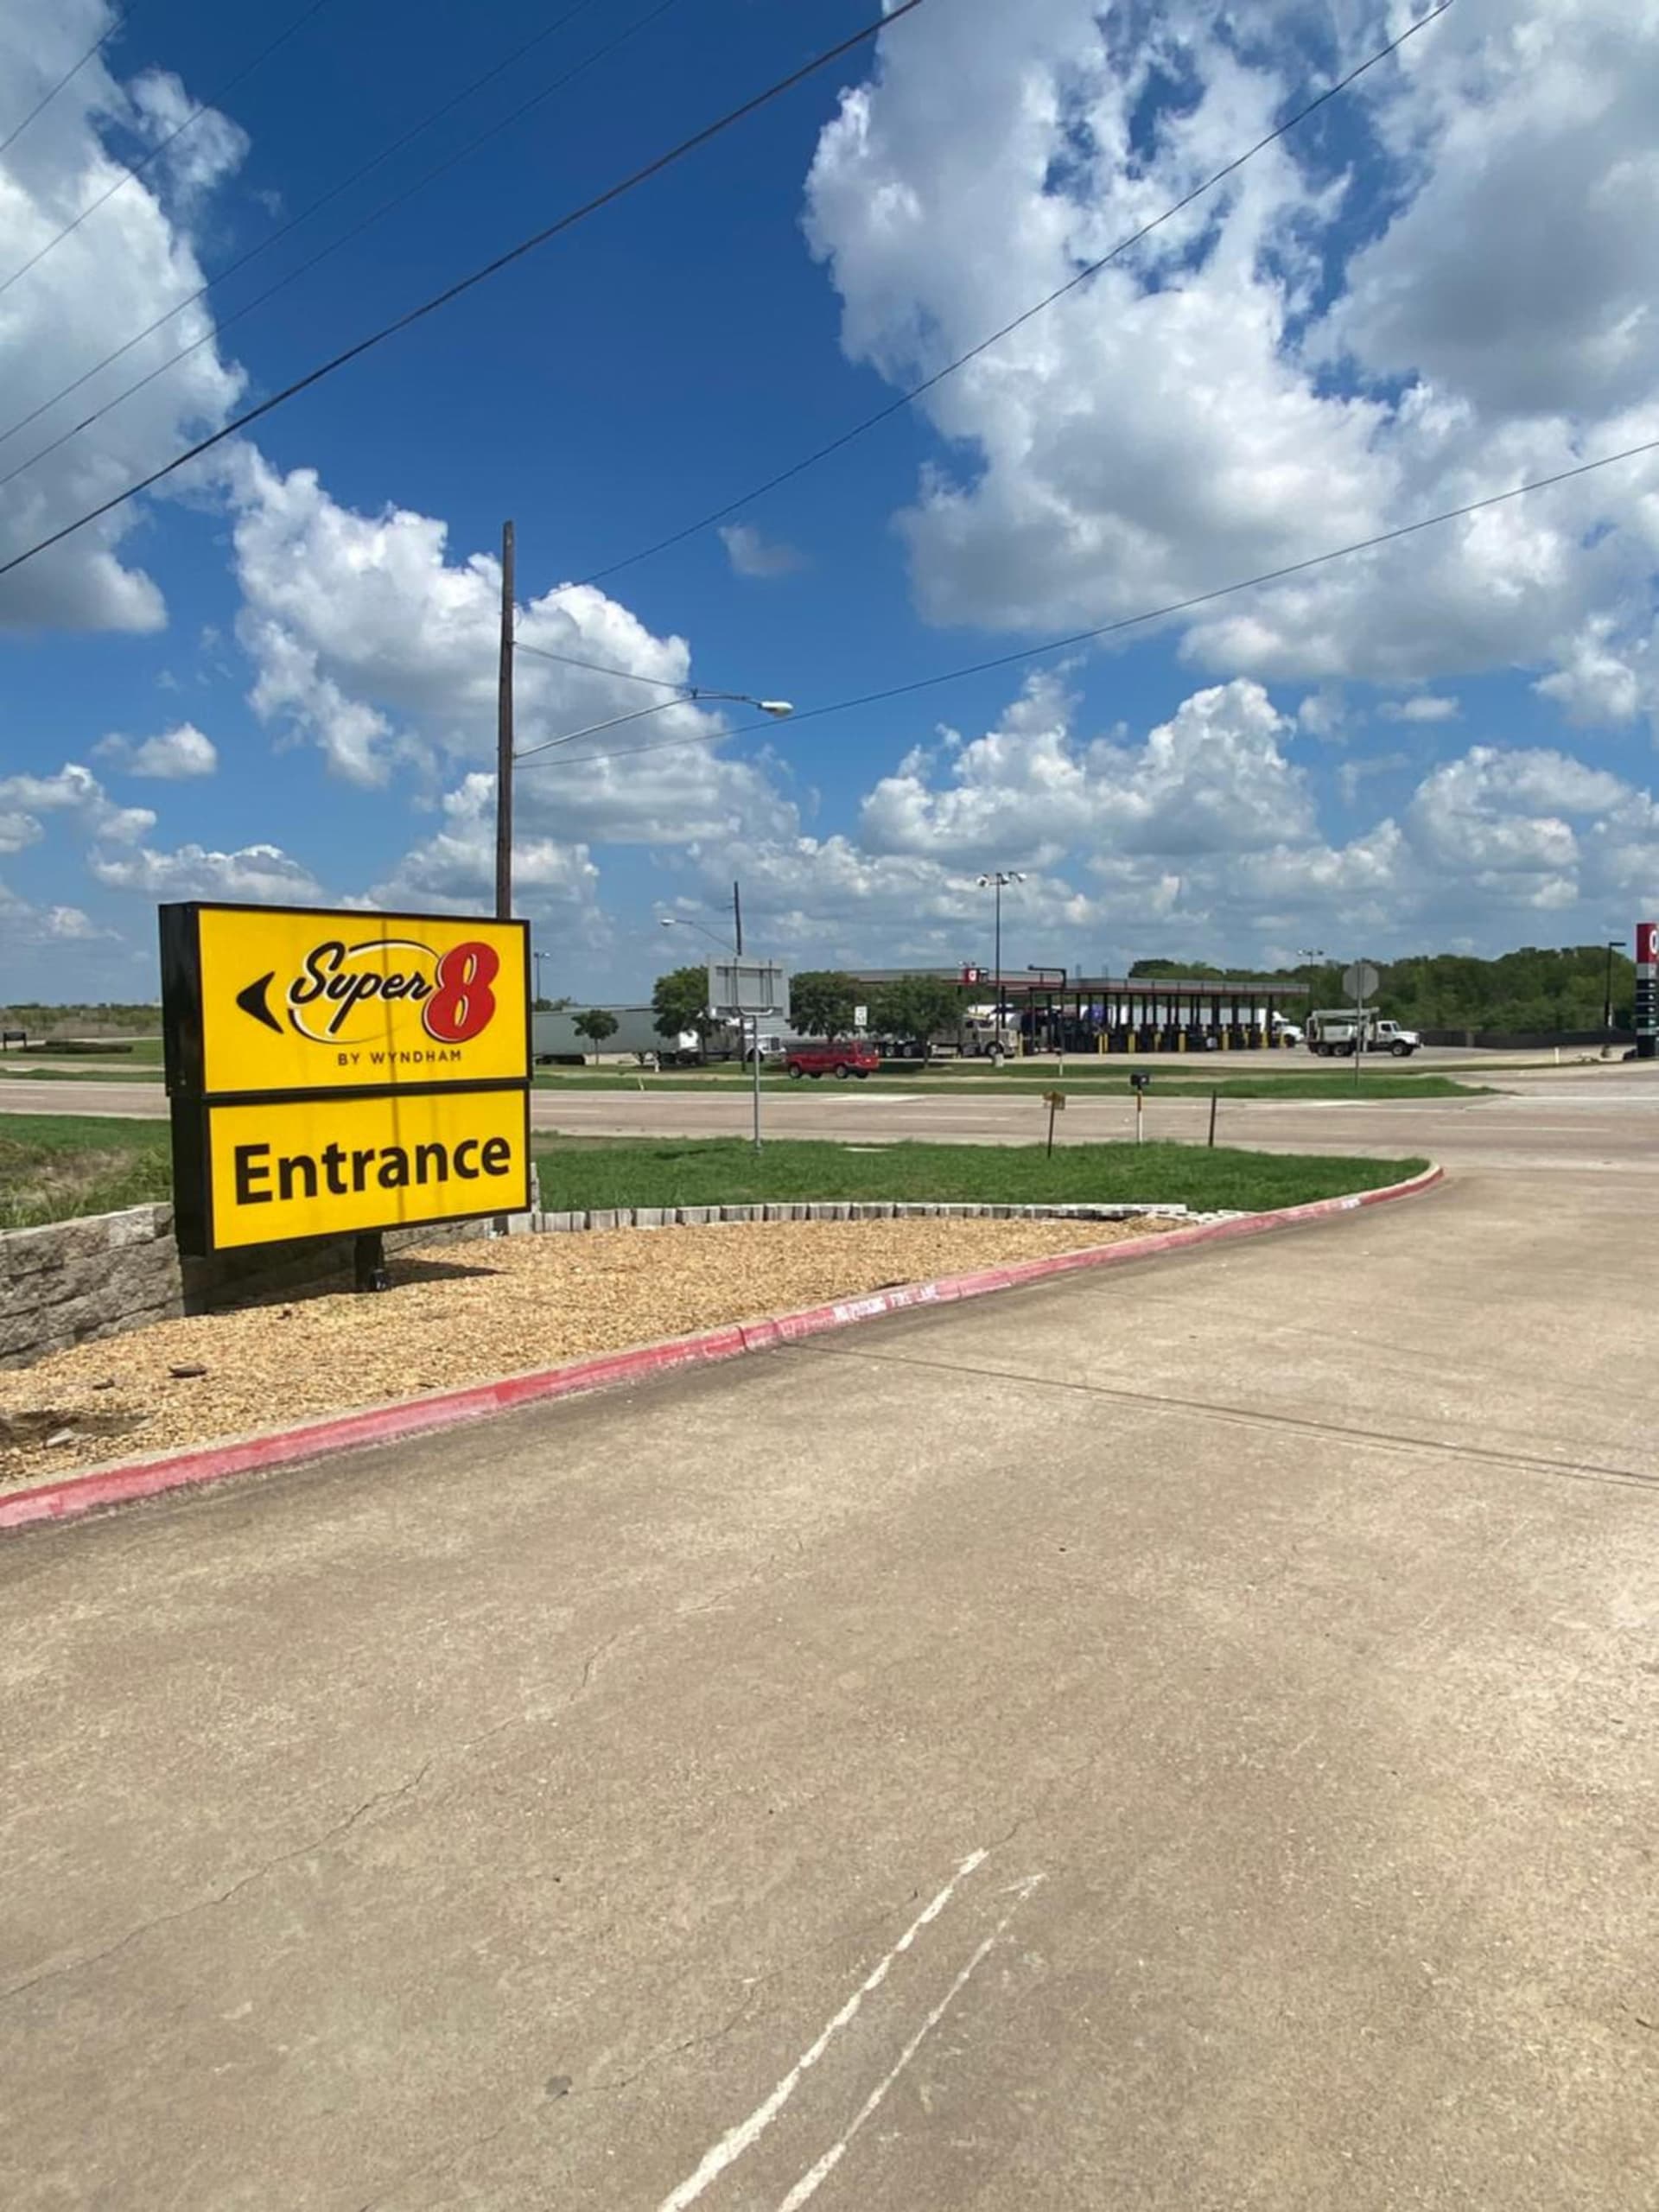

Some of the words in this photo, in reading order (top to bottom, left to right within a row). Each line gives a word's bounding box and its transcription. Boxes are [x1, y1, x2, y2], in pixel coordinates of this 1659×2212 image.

[289, 941, 433, 1035] Super
[422, 941, 500, 1045] 8
[337, 1052, 360, 1066] BY
[370, 1050, 462, 1065] WYNDHAM
[234, 1136, 512, 1206] Entrance
